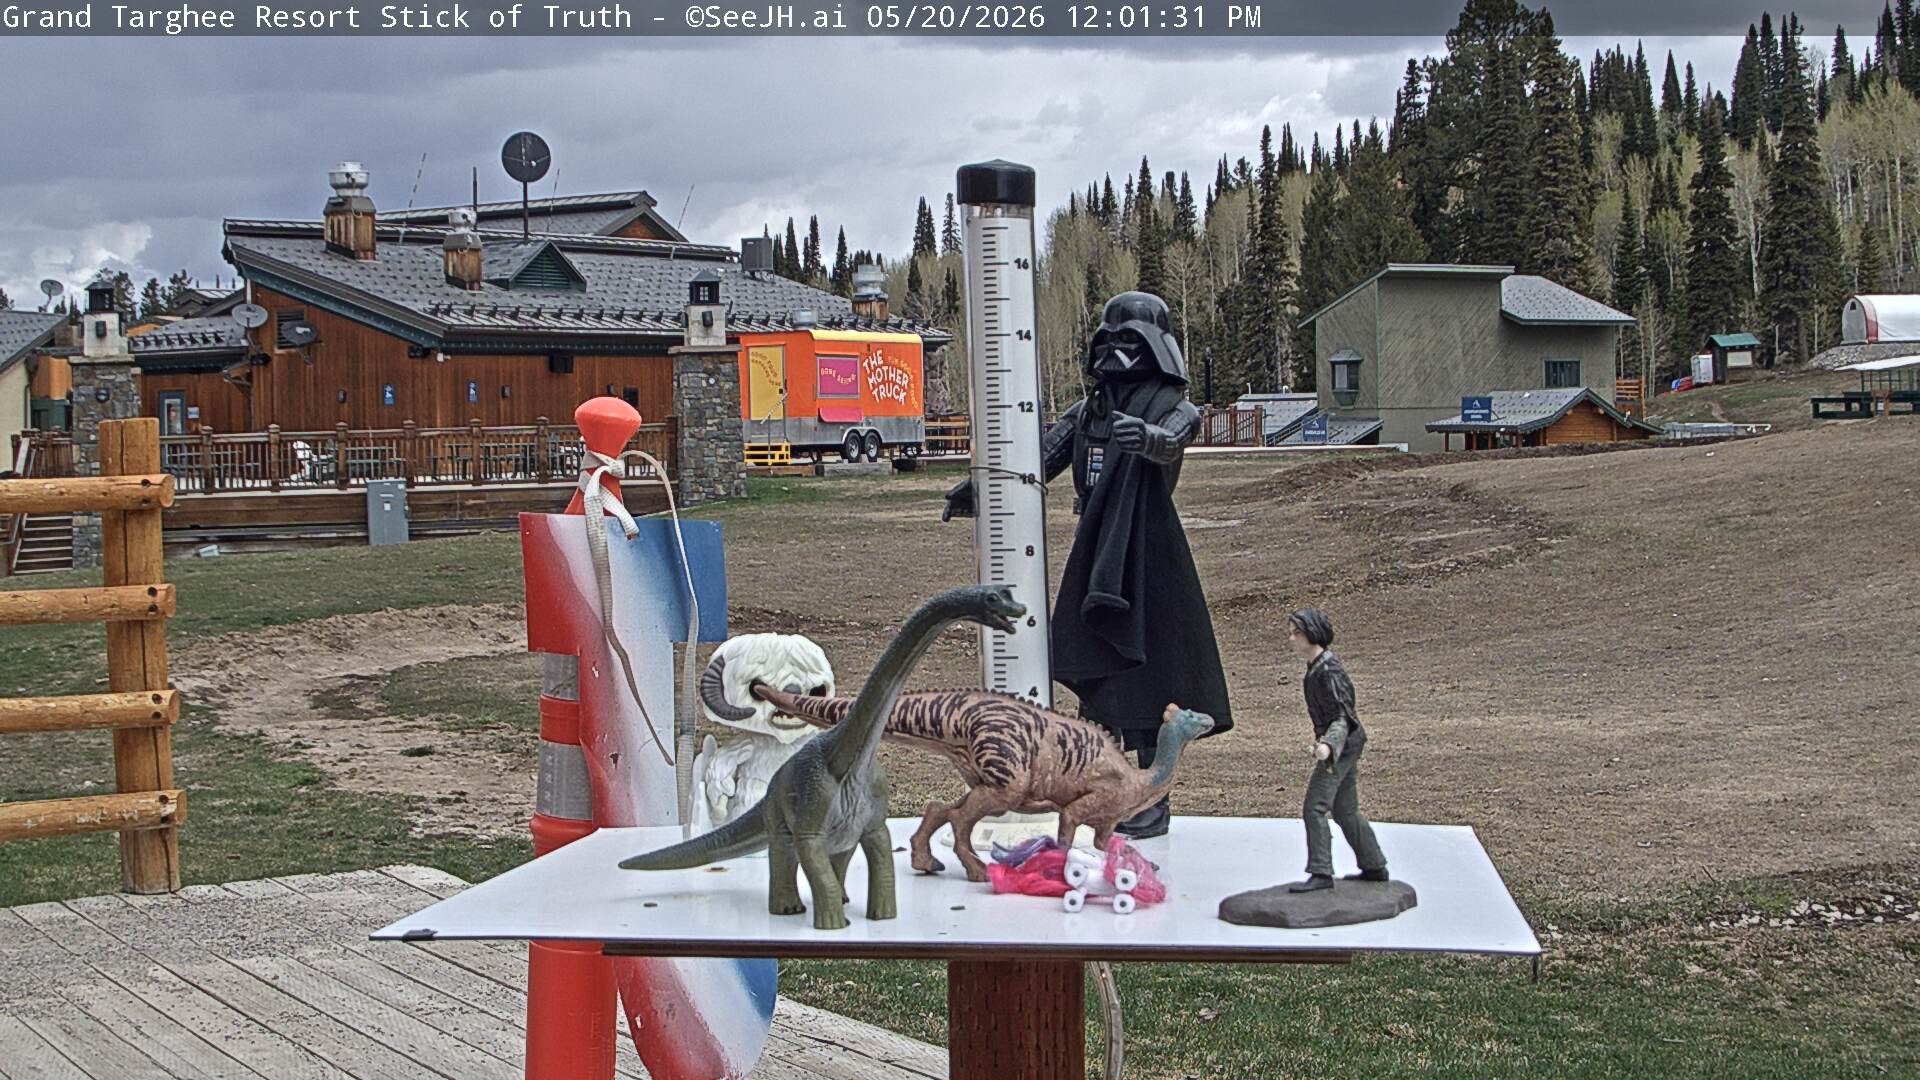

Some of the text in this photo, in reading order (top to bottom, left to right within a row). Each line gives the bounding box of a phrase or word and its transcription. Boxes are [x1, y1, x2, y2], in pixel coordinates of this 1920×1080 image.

[1013, 257, 1030, 271] 16
[1015, 329, 1032, 342] 14
[862, 349, 884, 374] THE
[867, 365, 909, 390] MOTHER
[871, 382, 907, 406] TRUCK
[1017, 400, 1034, 413] 12
[1024, 545, 1035, 557] 8
[1026, 615, 1037, 628] 6
[1028, 686, 1039, 698] 4
